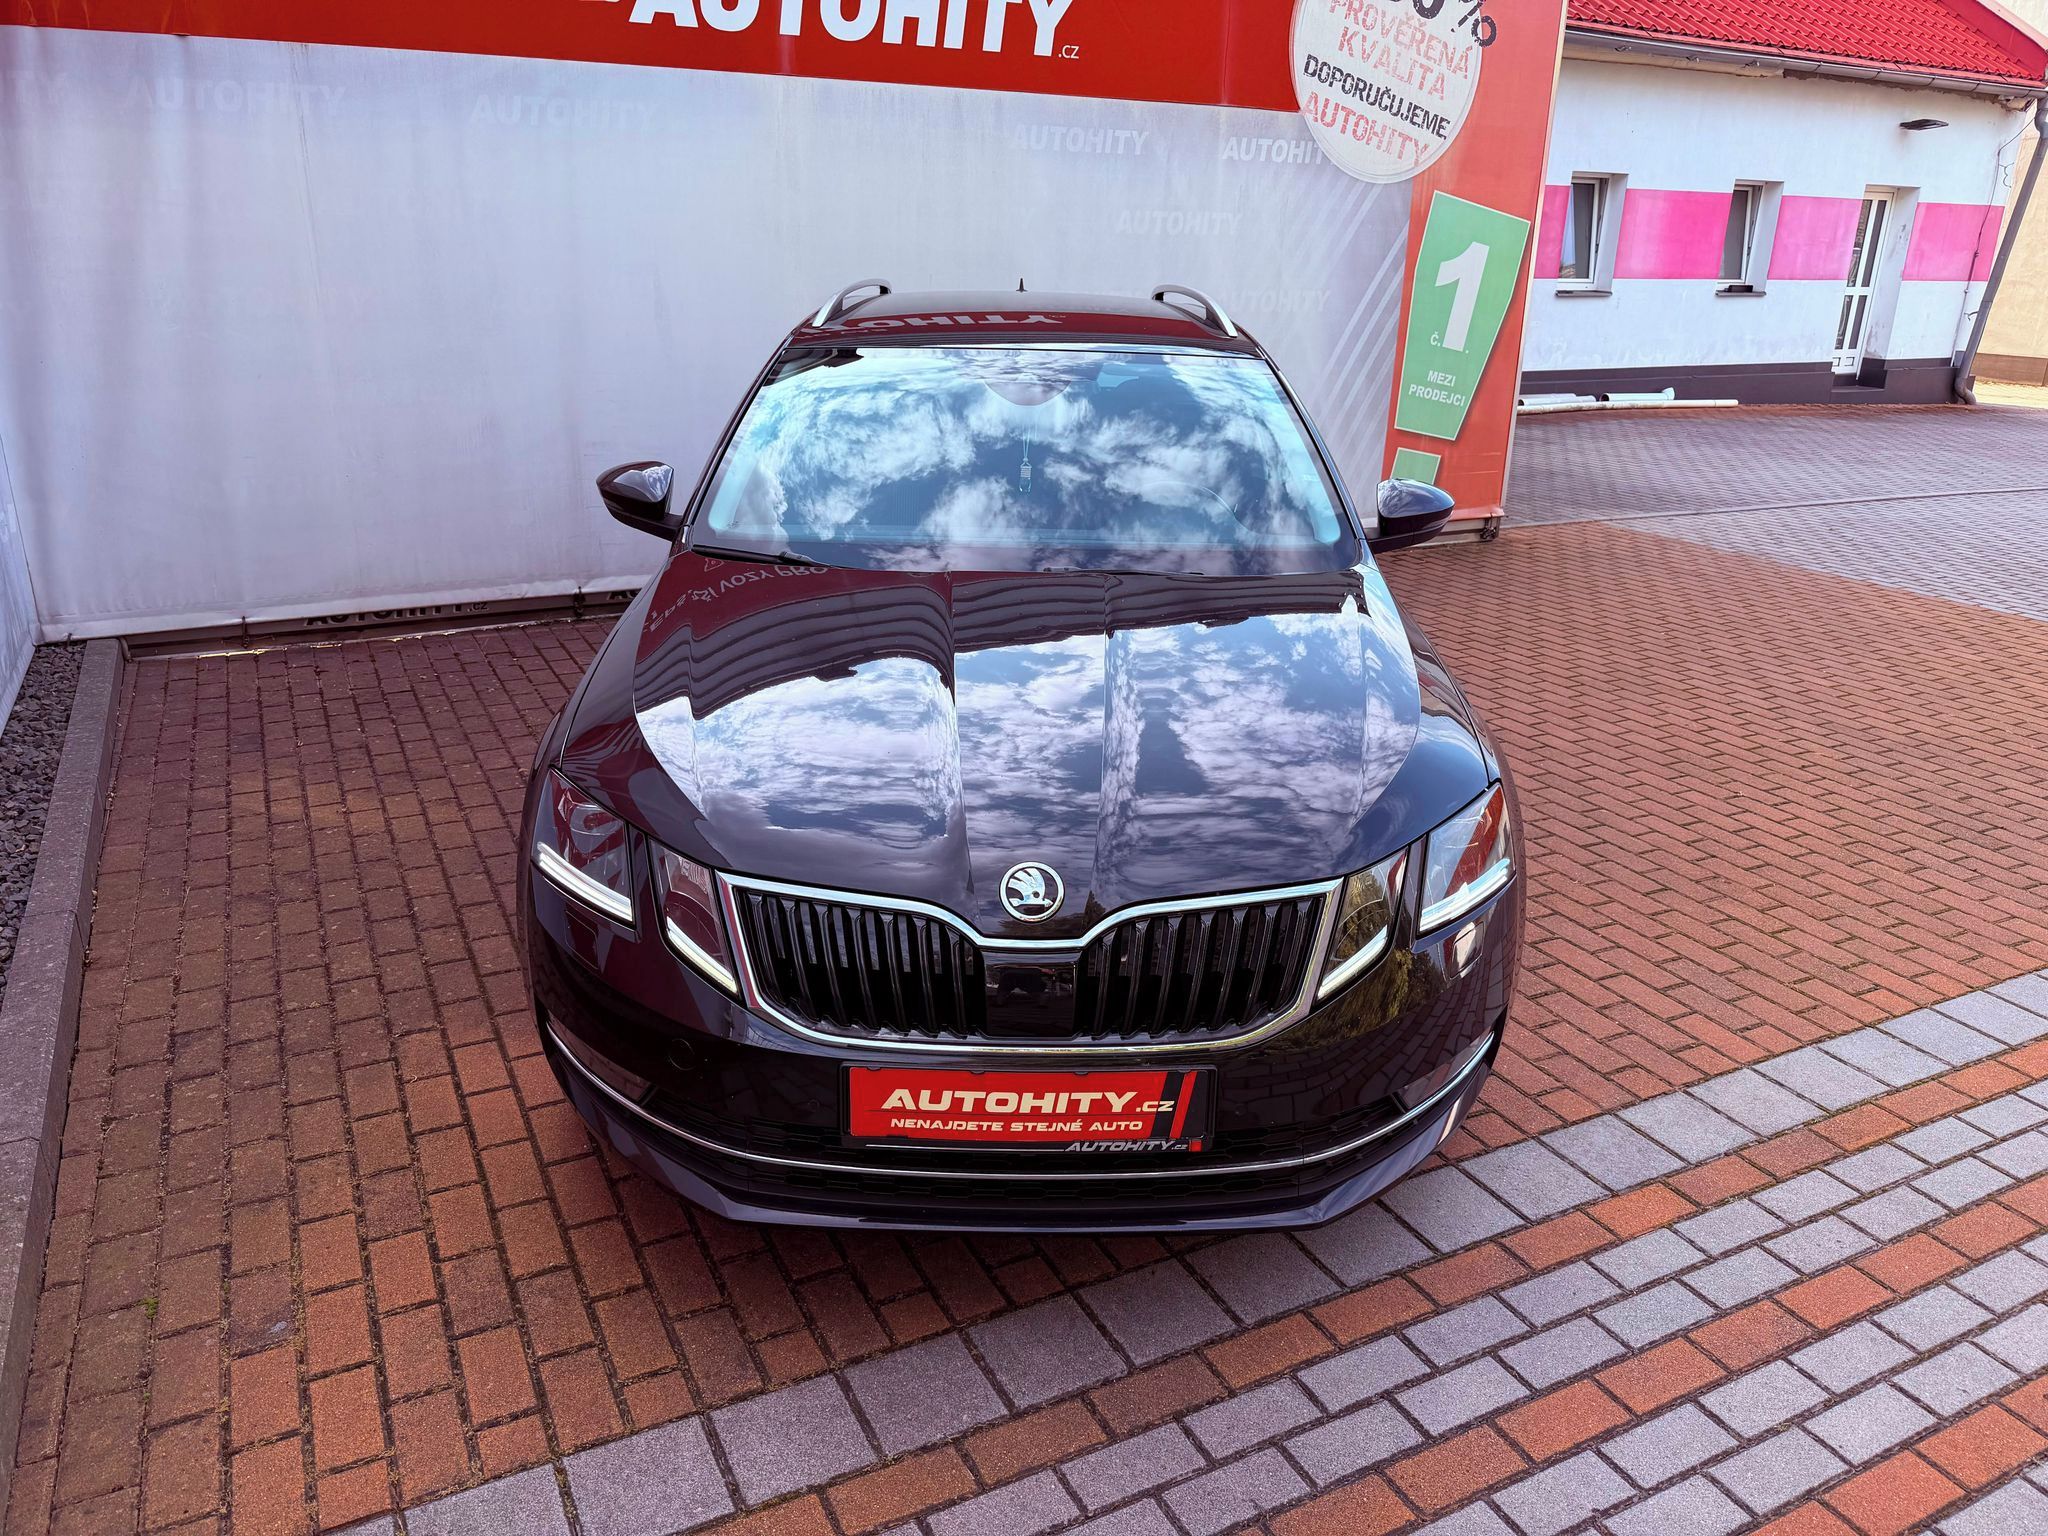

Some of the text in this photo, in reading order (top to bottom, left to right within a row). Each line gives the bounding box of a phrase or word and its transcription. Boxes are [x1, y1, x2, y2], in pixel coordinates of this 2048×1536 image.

[1338, 26, 1446, 101] KVALITA
[1303, 53, 1452, 141] DOPORUČUJEME
[1008, 124, 1149, 156] AUTOHITY
[1300, 90, 1431, 168] AUTOHITY
[1221, 136, 1337, 166] AUTOHIT
[1427, 369, 1456, 387] MEZI
[1408, 384, 1466, 407] PRODEJCI
[890, 1118, 1143, 1133] NENAJDETE STEJNÉ AUTO
